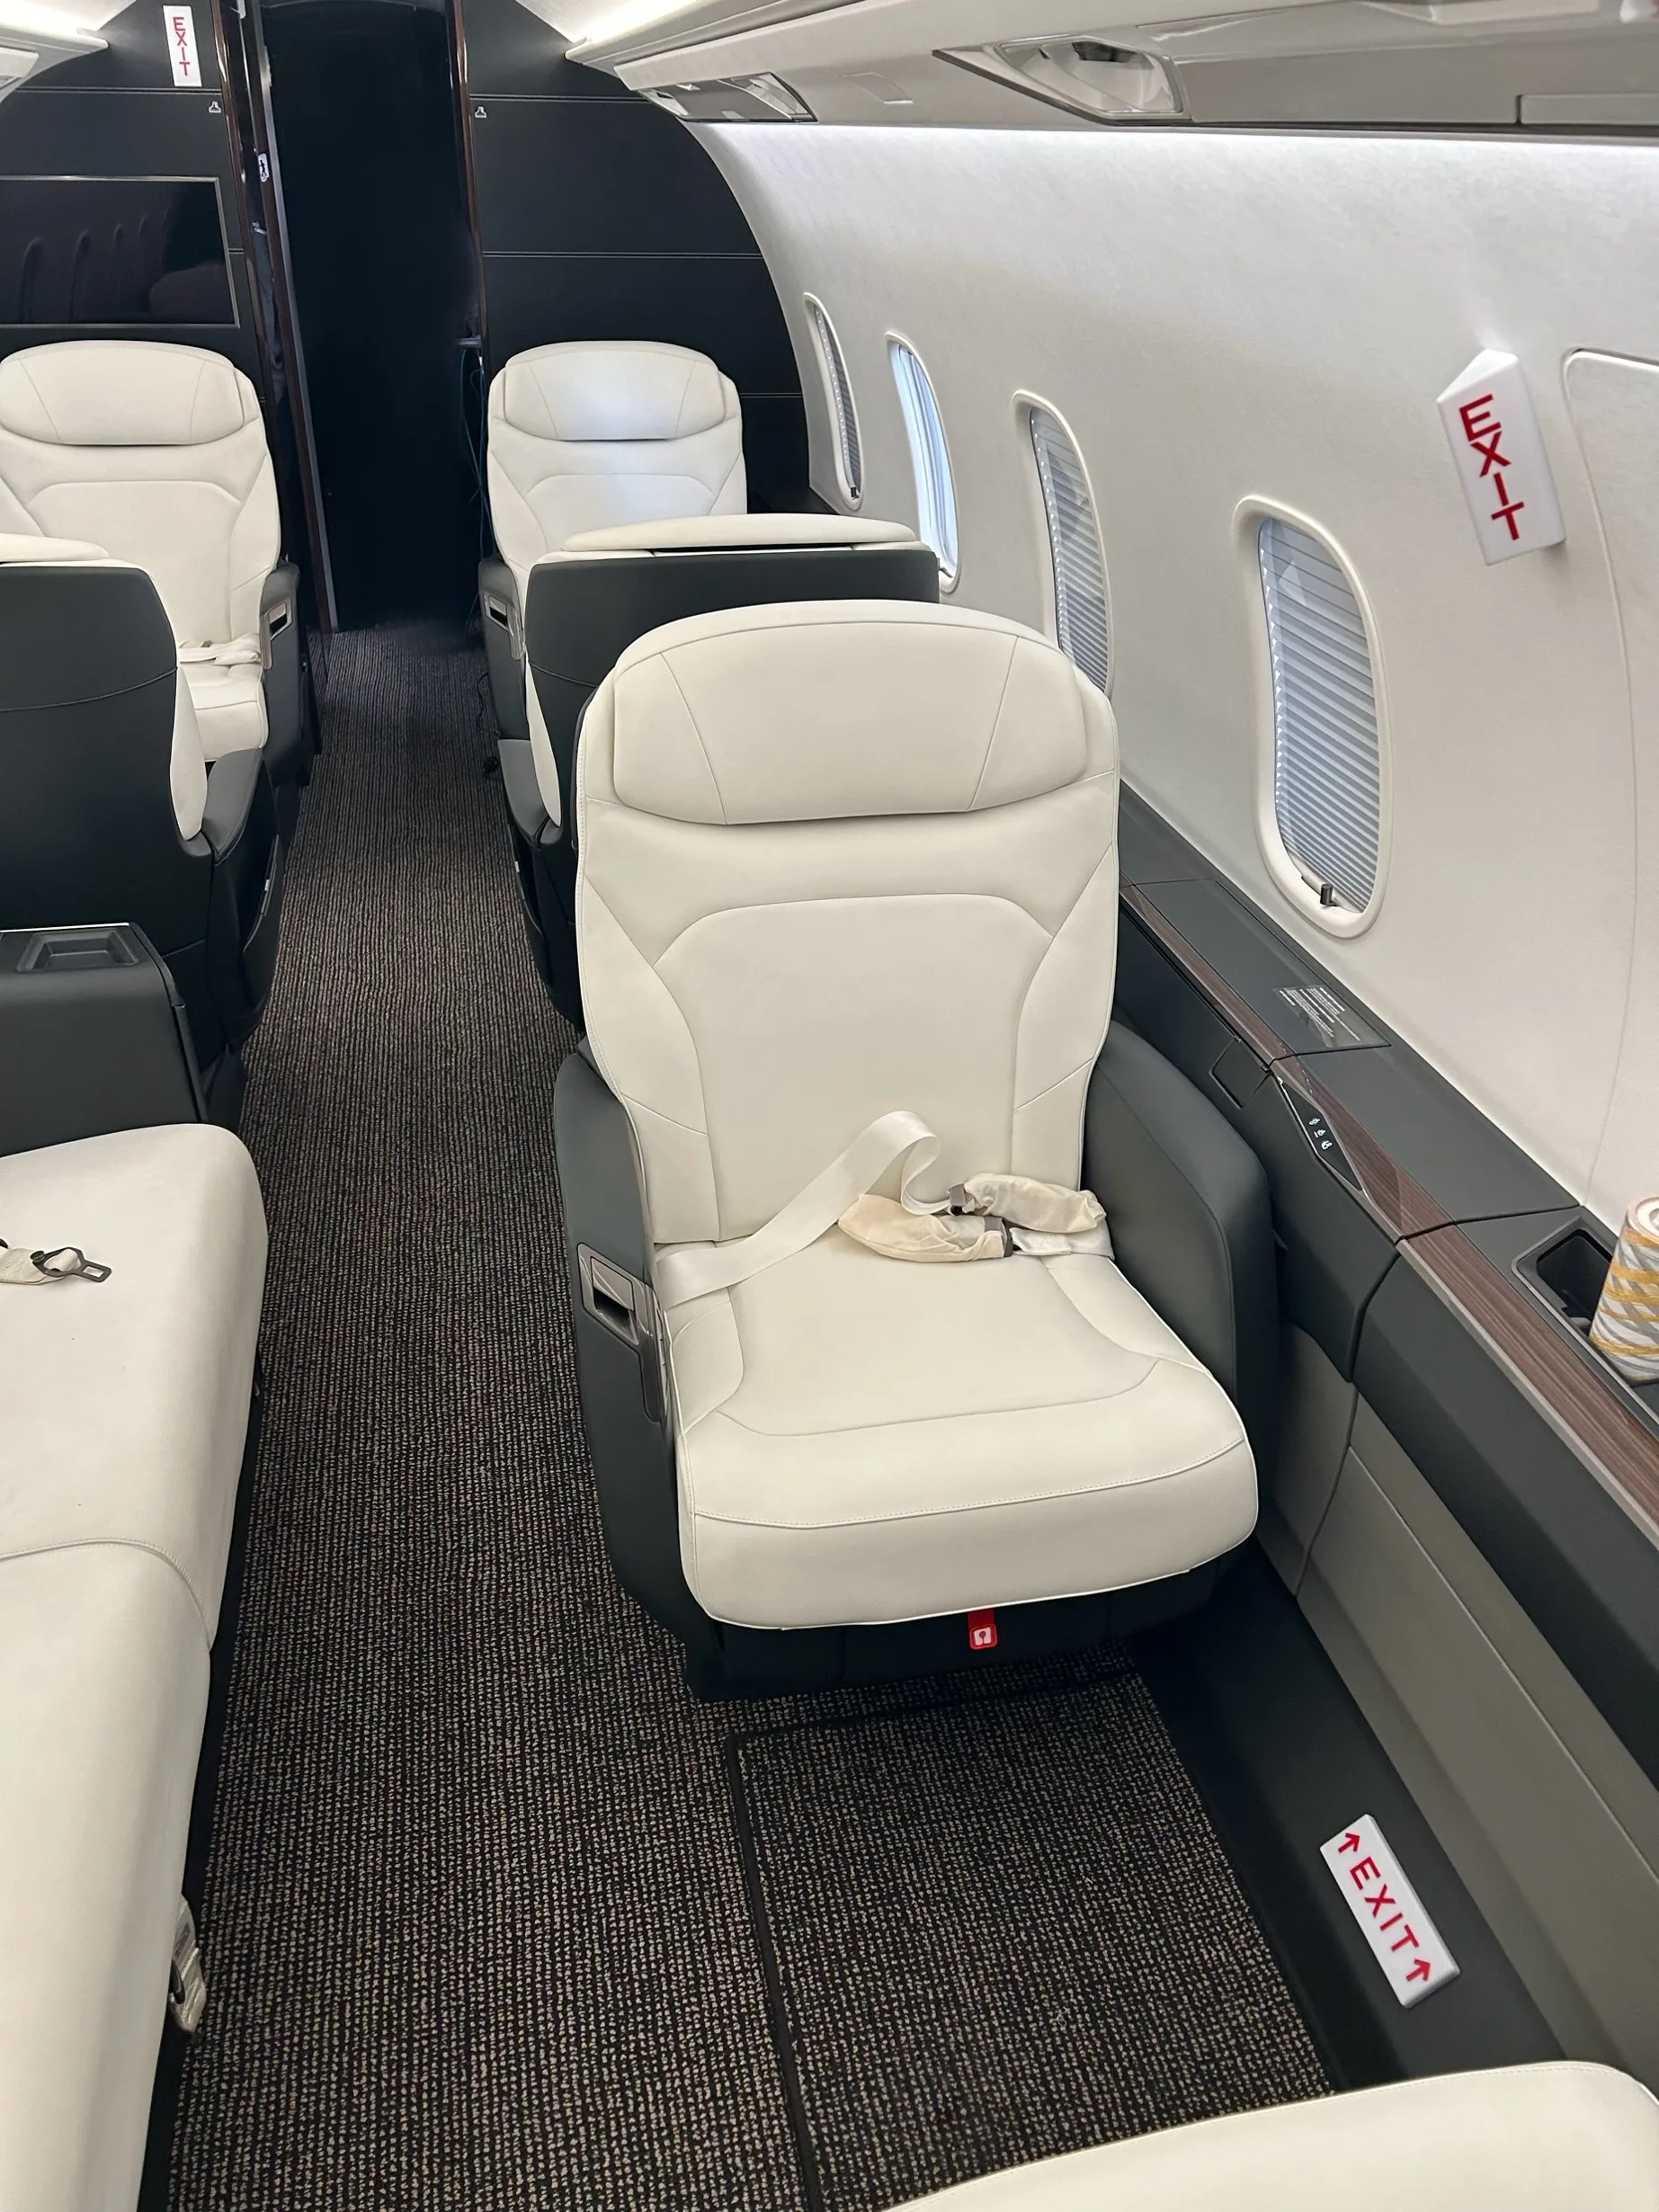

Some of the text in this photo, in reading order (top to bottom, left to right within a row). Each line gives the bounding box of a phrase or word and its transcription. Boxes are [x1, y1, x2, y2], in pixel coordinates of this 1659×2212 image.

[173, 17, 190, 76] EXIT
[1458, 392, 1524, 540] EXIT
[1349, 1855, 1421, 1952] EXIT
